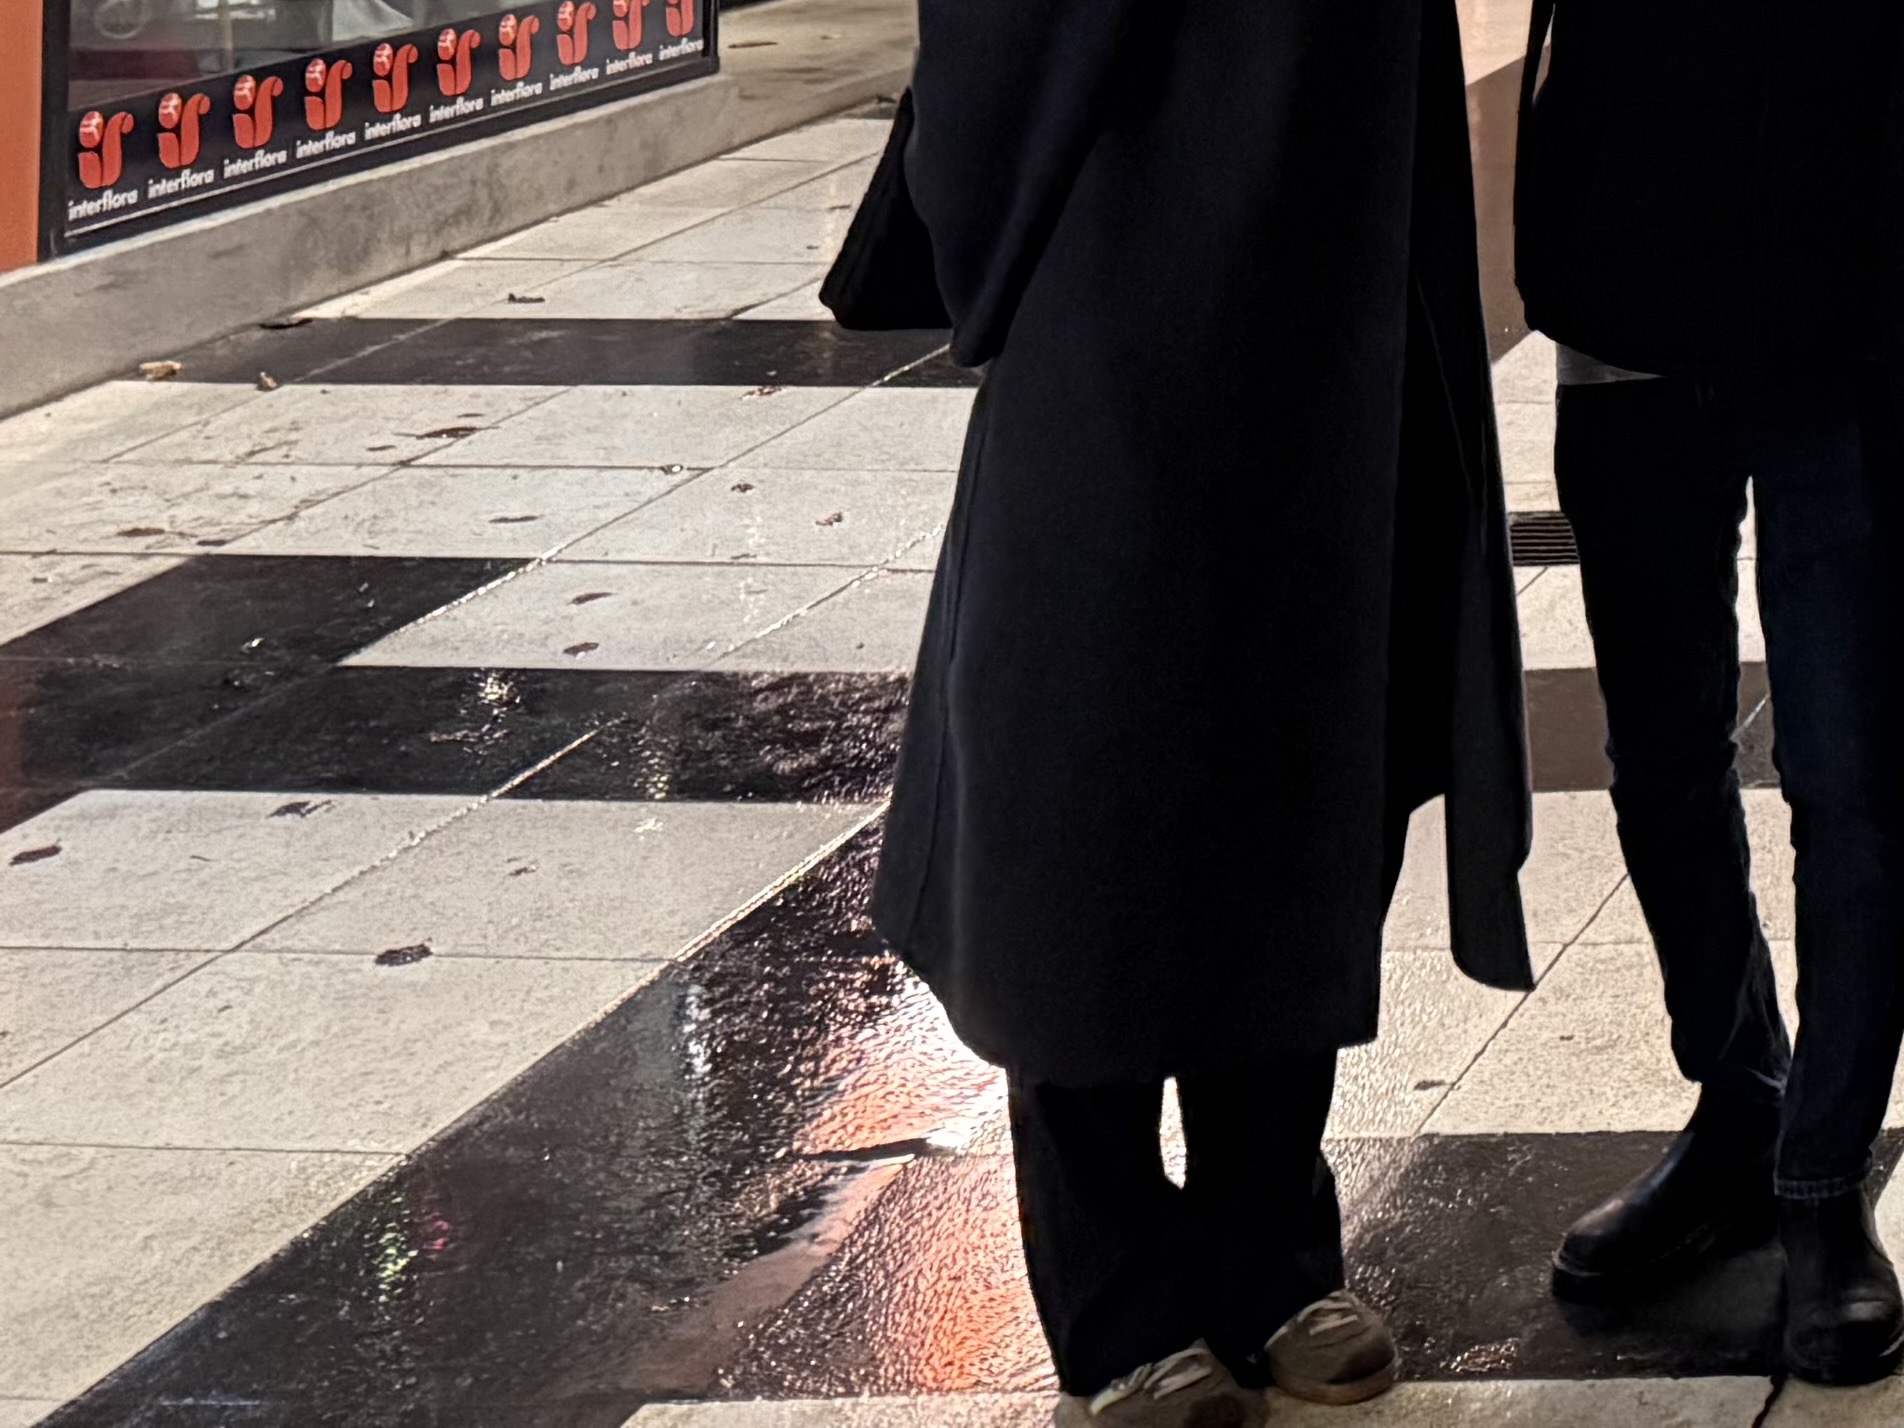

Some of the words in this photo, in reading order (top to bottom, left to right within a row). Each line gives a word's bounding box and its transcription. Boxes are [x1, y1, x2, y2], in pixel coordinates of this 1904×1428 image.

[68, 187, 138, 221] interflora
[148, 167, 215, 199] interflora
[223, 149, 288, 179] interflora
[296, 130, 357, 159] interflora
[364, 113, 422, 140] interflora
[429, 96, 484, 122] interflora
[490, 81, 543, 106] interflora
[550, 66, 599, 90] interflora
[606, 50, 653, 75] interflora
